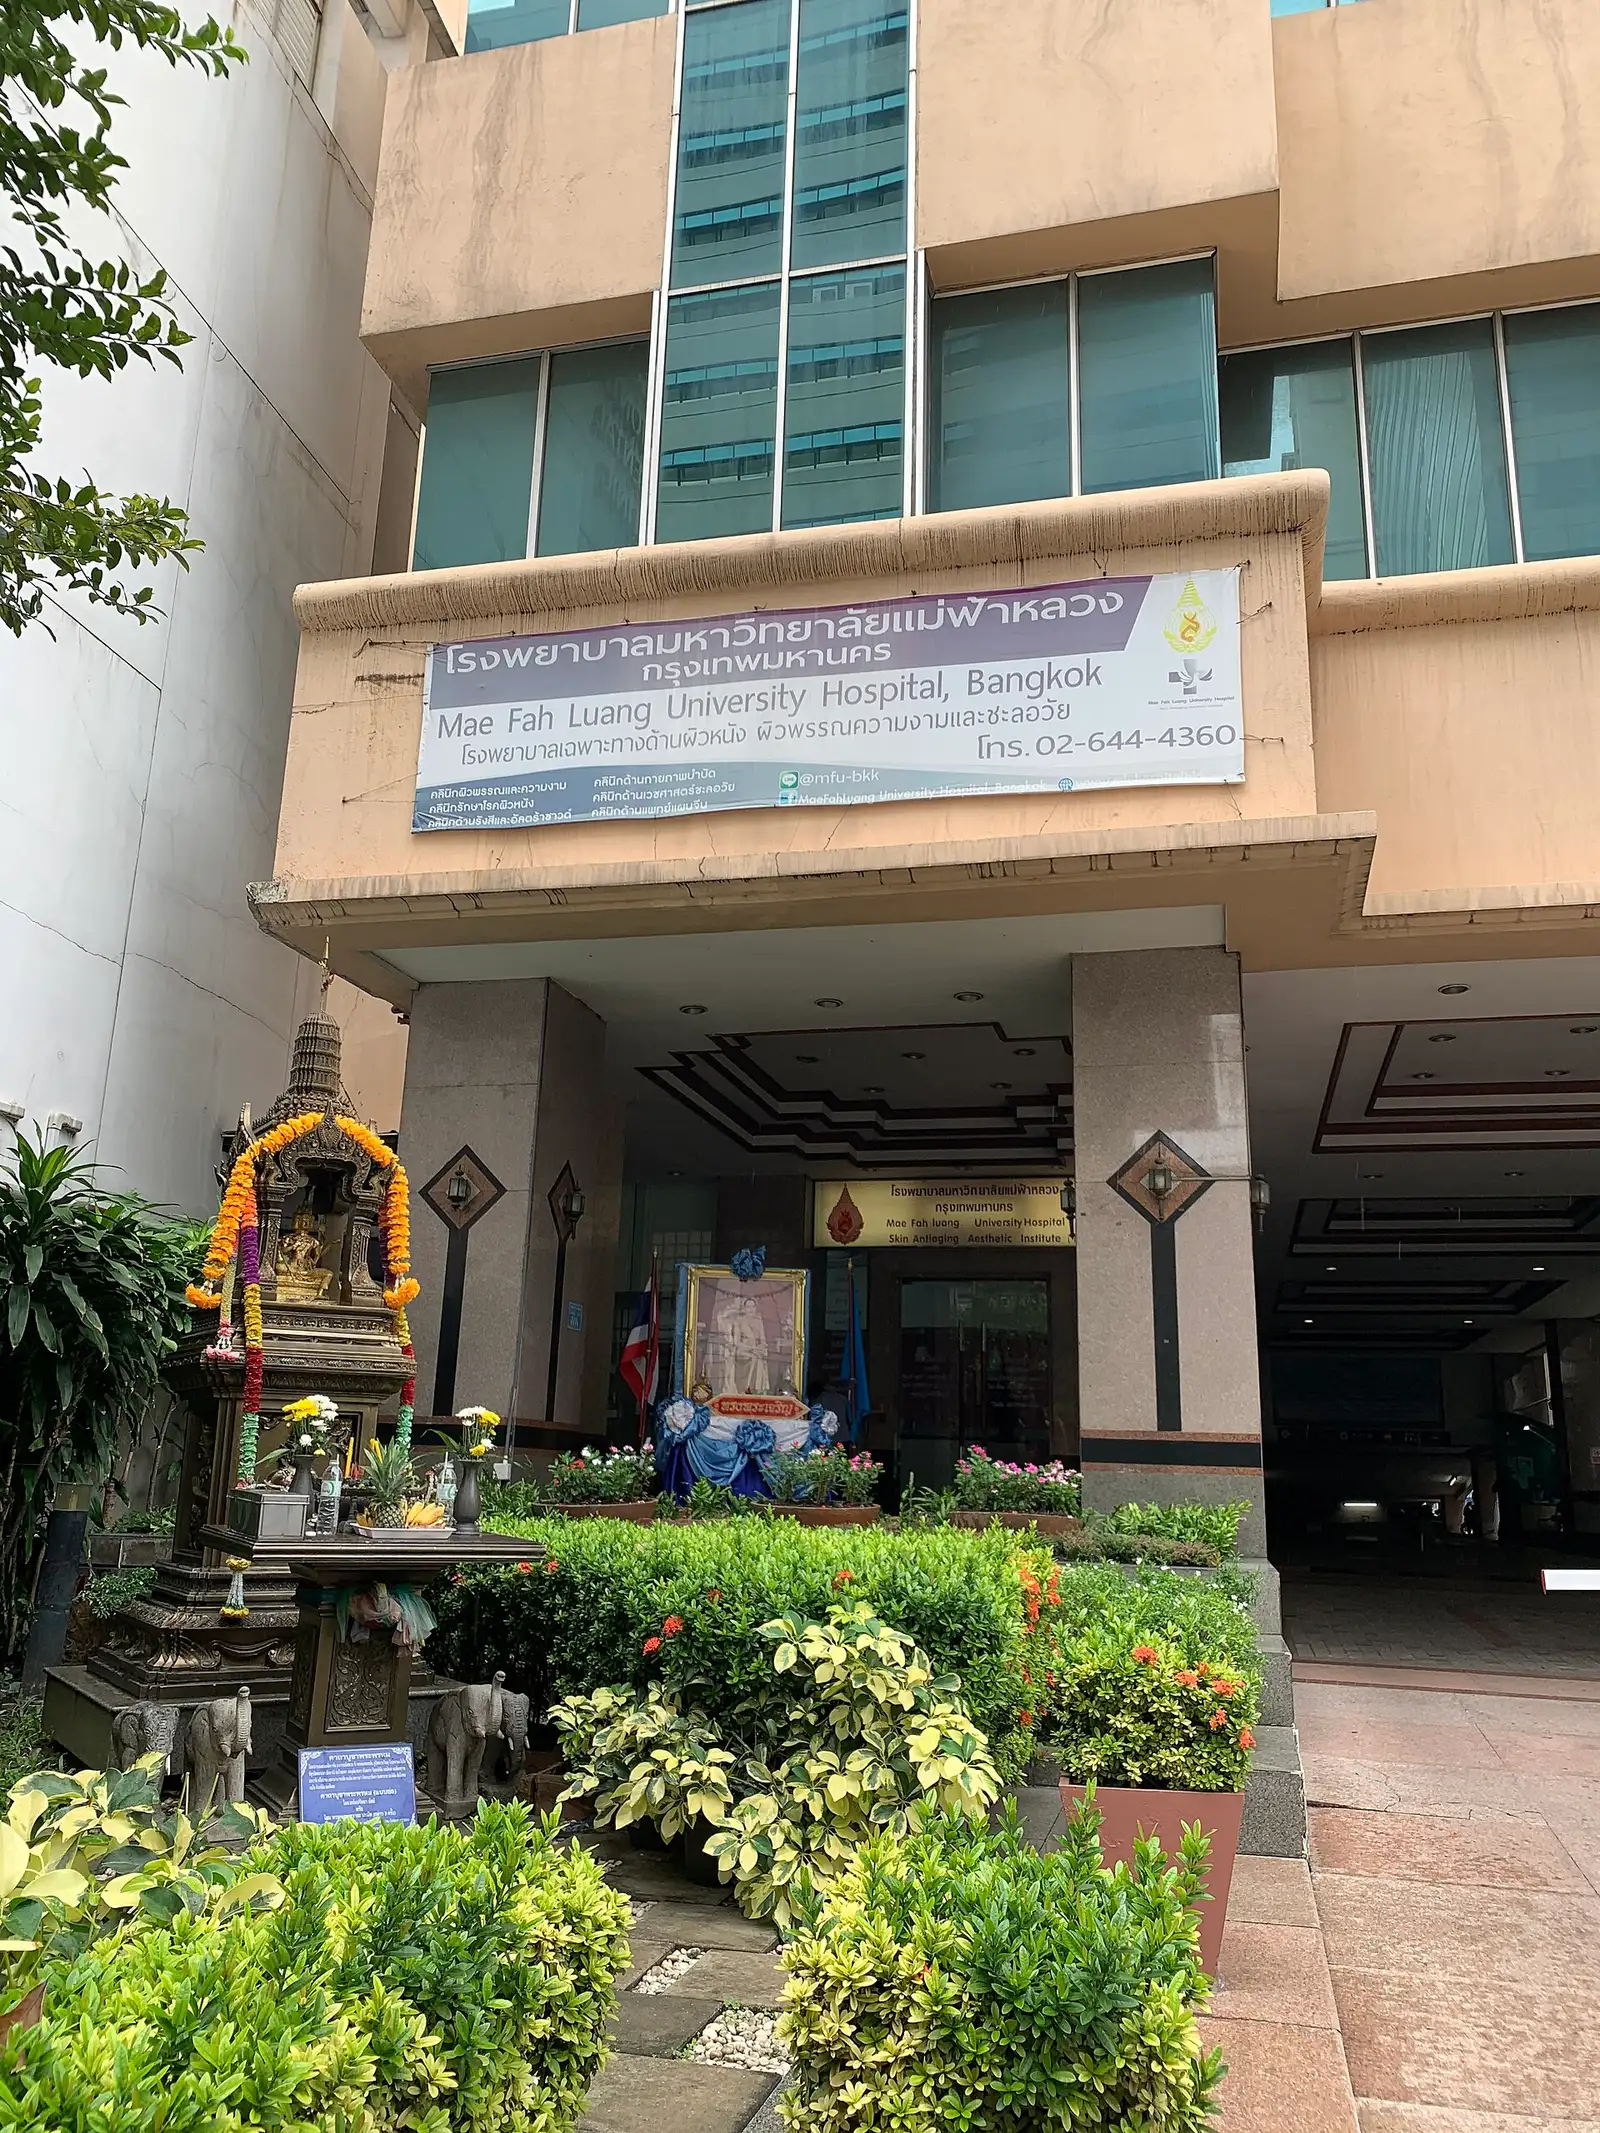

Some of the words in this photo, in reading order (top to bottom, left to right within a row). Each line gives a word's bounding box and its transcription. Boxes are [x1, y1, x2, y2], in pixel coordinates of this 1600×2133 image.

[445, 591, 1124, 674] โรงพยาบาลมหาวิทยาลัยแม่ฟ้าหลวง
[642, 642, 892, 686] กรุงเทพมหานคร
[437, 712, 494, 739] Mae
[508, 704, 554, 733] Fah
[568, 701, 651, 730] Luang
[667, 683, 807, 719] University
[822, 670, 949, 711] Hospital,
[967, 658, 1103, 700] Bangkok
[461, 722, 747, 765] โรงพยาบาลเฉพาะทางด้านผิวหนัง
[757, 698, 1071, 741] ผิวพรรณความงามและชะลอวัย
[800, 768, 880, 786] @mfu-bkk
[886, 1218, 907, 1228] Mae
[911, 1218, 928, 1228] Fah
[974, 1217, 1022, 1229] University
[1024, 1217, 1065, 1228] Hospital
[935, 1202, 1014, 1215] กรุงเทพมหานคร
[889, 1234, 909, 1243] Skin
[968, 1233, 1013, 1243] Aesthetic
[1020, 1233, 1062, 1243] Institute
